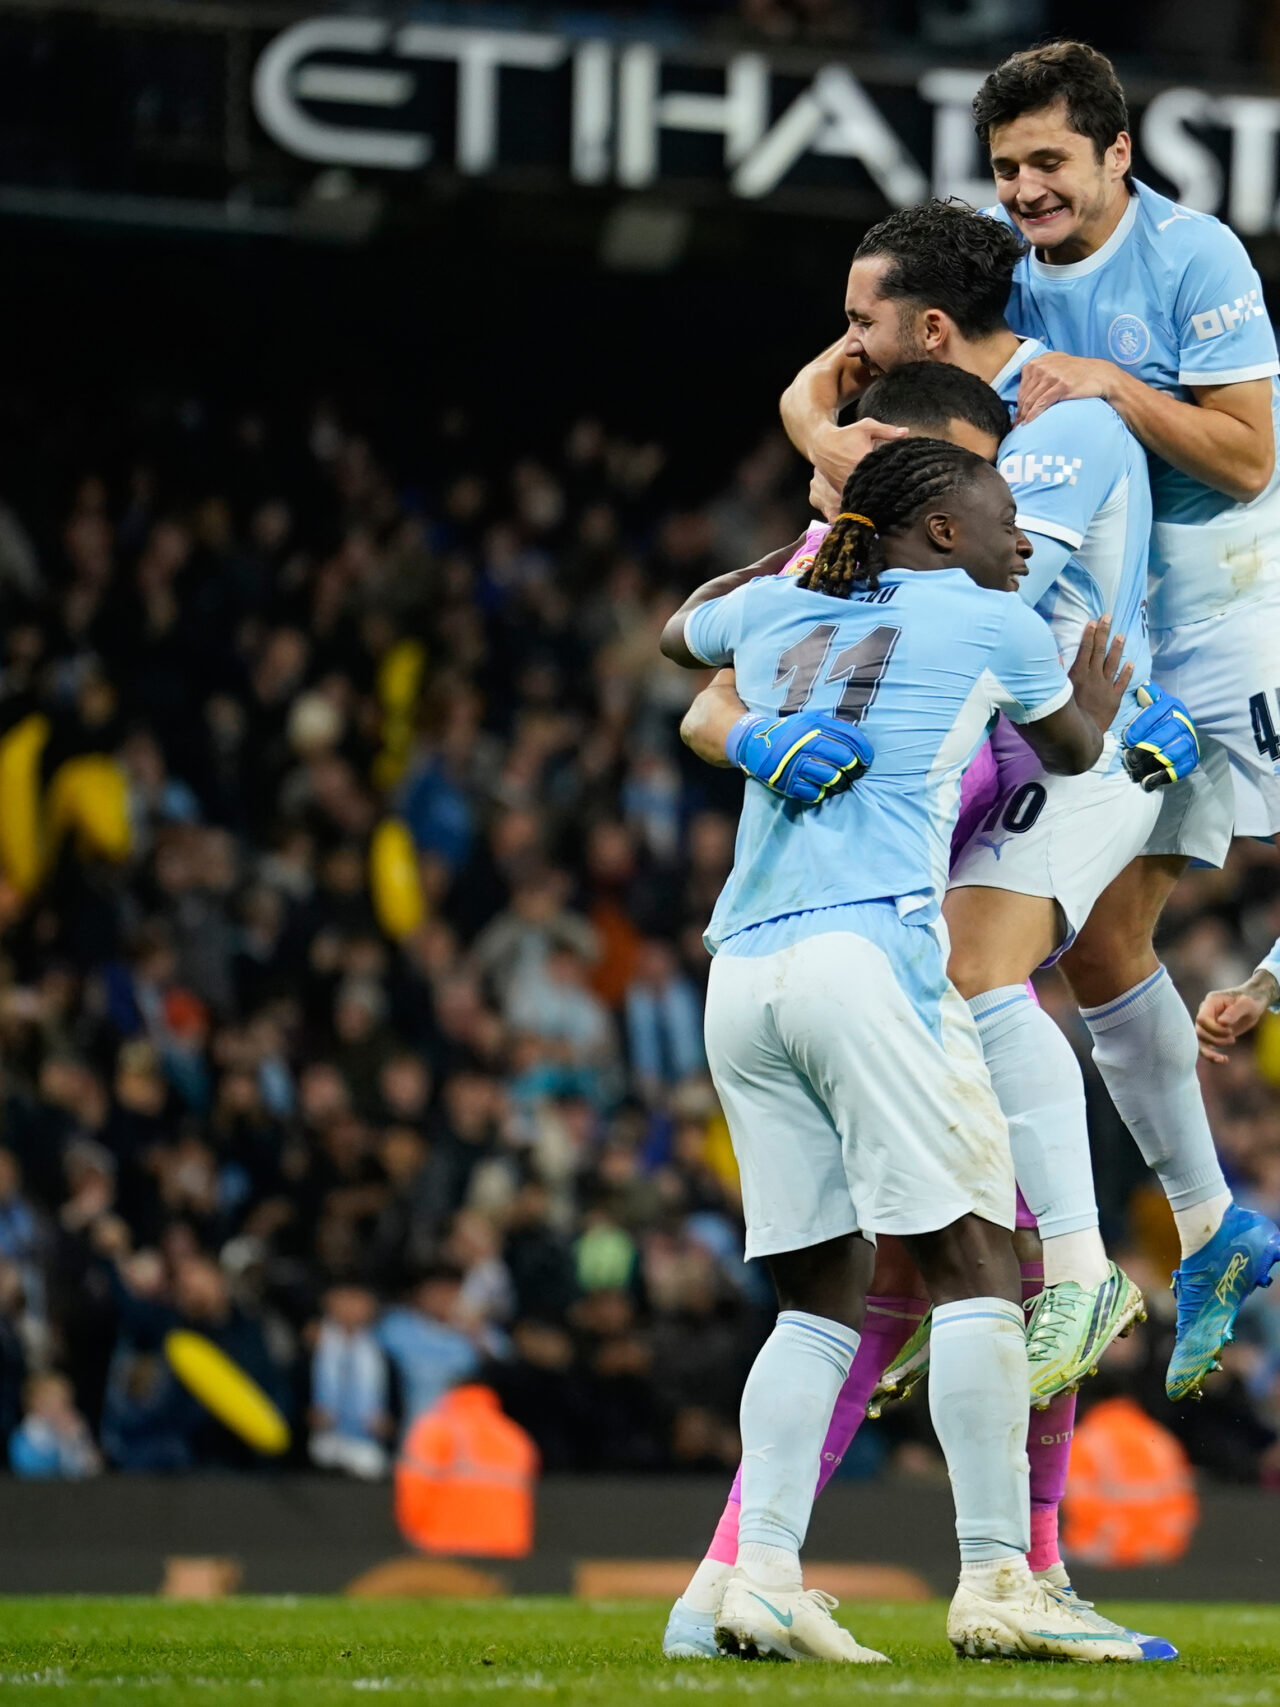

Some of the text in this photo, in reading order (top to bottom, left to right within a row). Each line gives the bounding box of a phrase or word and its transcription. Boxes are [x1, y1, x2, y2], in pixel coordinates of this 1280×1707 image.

[1191, 289, 1264, 341] OKX
[999, 455, 1082, 486] OKX
[772, 622, 902, 727] 11
